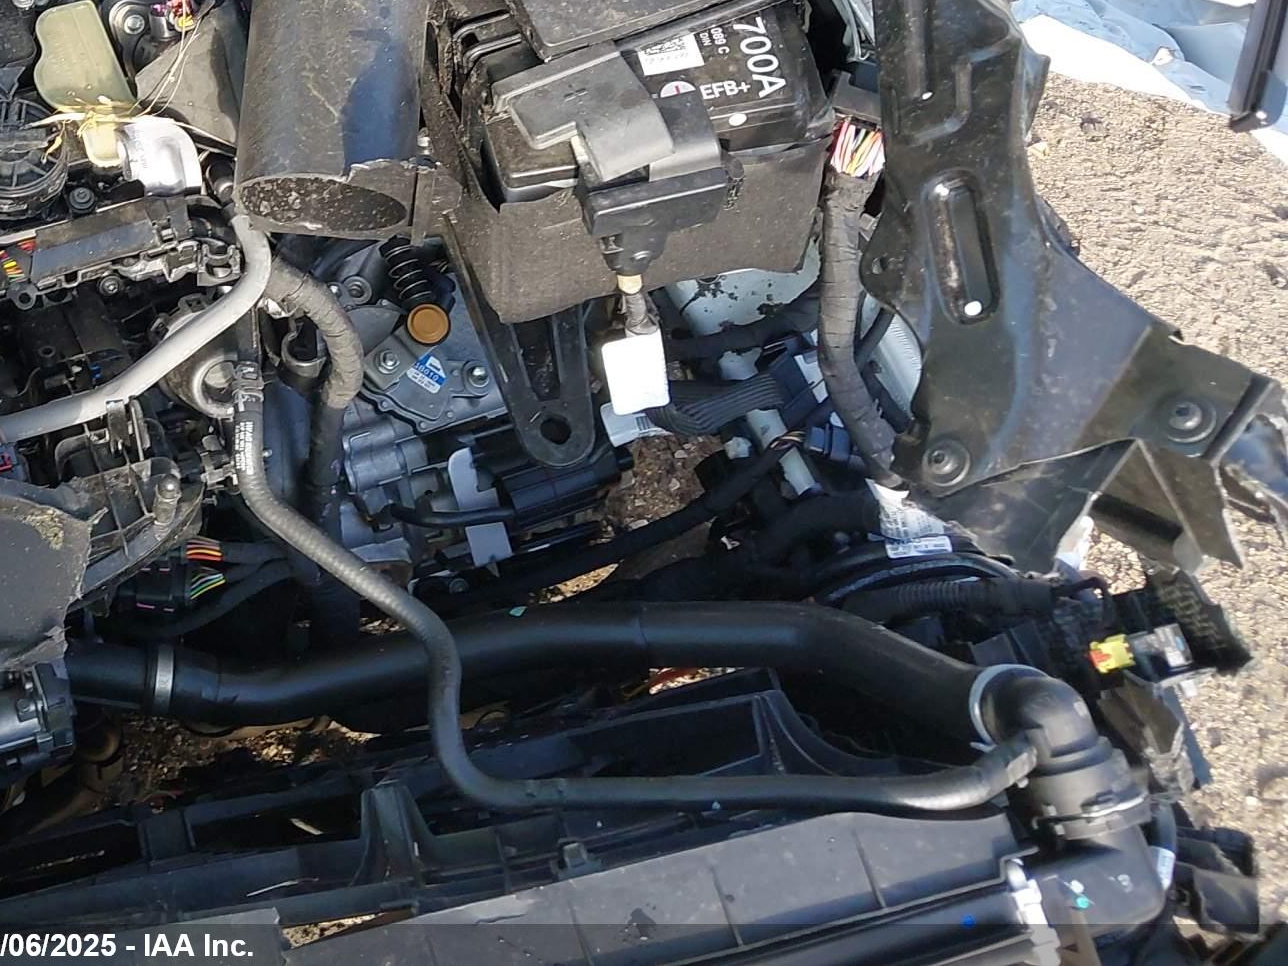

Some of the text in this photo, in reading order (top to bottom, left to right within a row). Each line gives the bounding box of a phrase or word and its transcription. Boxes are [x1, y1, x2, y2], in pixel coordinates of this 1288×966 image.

[699, 32, 713, 47] DIN
[710, 27, 730, 55] 089 C
[733, 17, 787, 98] 700A
[699, 80, 751, 100] EFB+
